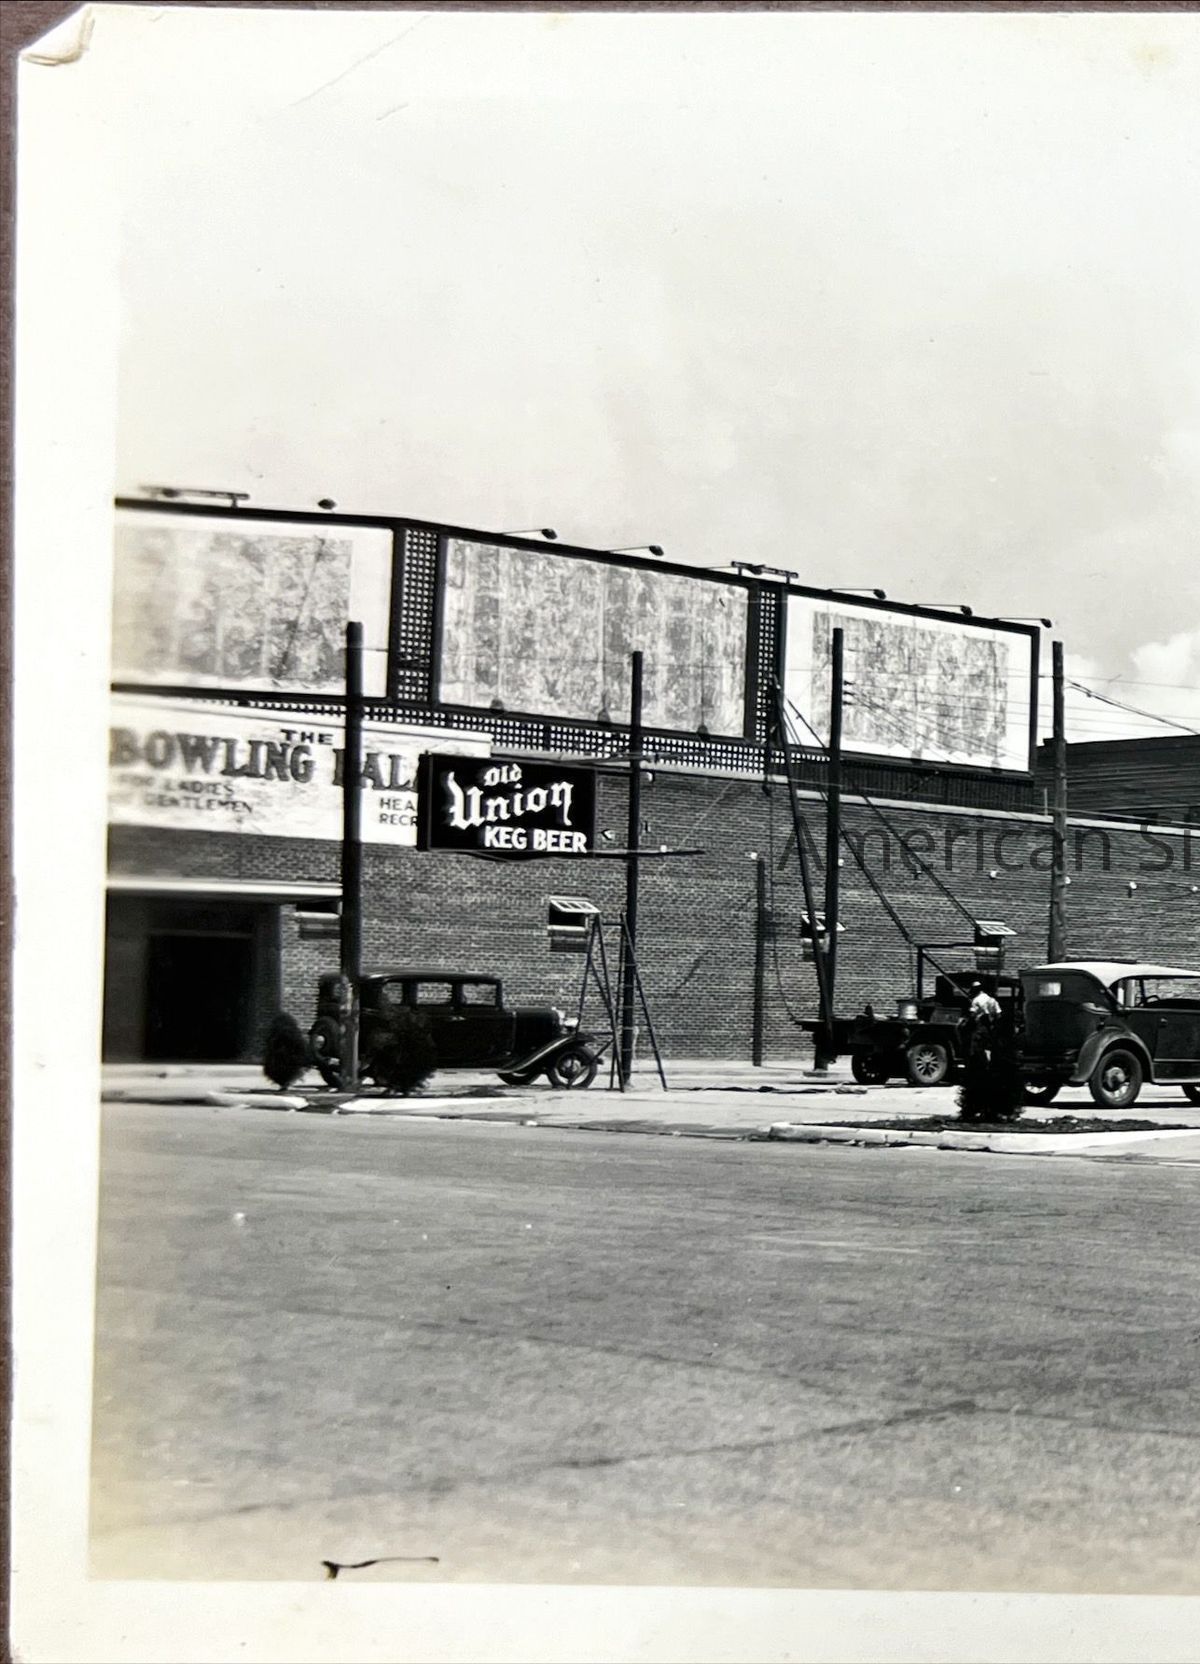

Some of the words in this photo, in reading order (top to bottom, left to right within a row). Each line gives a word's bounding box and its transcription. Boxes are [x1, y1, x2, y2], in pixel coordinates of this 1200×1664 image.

[281, 729, 333, 745] THE
[109, 727, 315, 783] BOWLING
[332, 749, 418, 792] AL
[164, 778, 234, 796] LADIES
[484, 763, 523, 787] Old
[447, 771, 574, 831] Union
[485, 826, 527, 849] KEG
[533, 829, 587, 853] BEER
